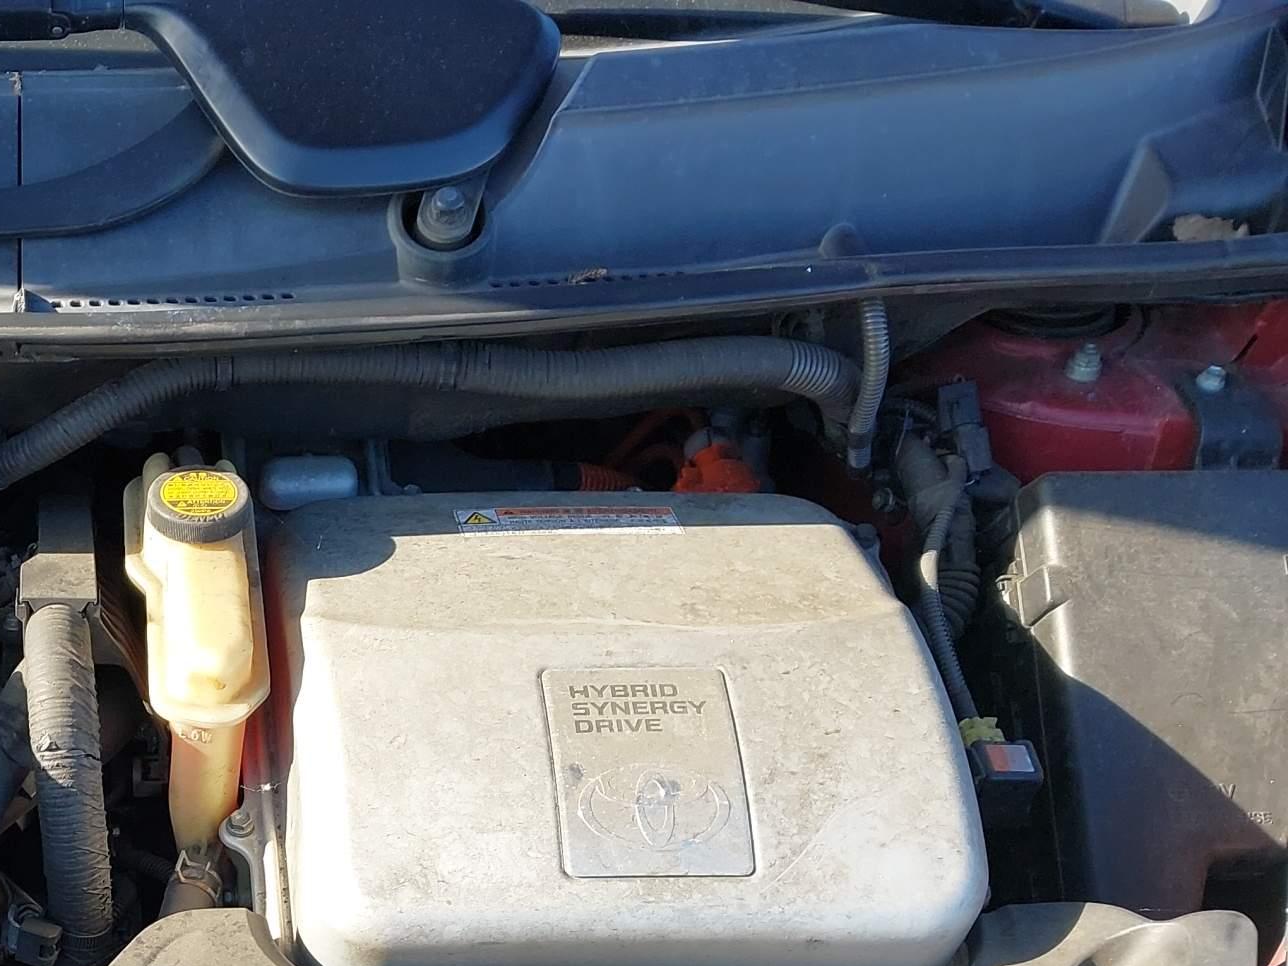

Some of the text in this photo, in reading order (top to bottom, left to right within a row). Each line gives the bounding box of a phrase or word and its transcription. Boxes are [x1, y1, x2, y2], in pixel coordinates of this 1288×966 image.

[569, 684, 679, 698] HYBRID
[571, 701, 707, 716] SYNERGY
[574, 719, 663, 733] DRIVE
